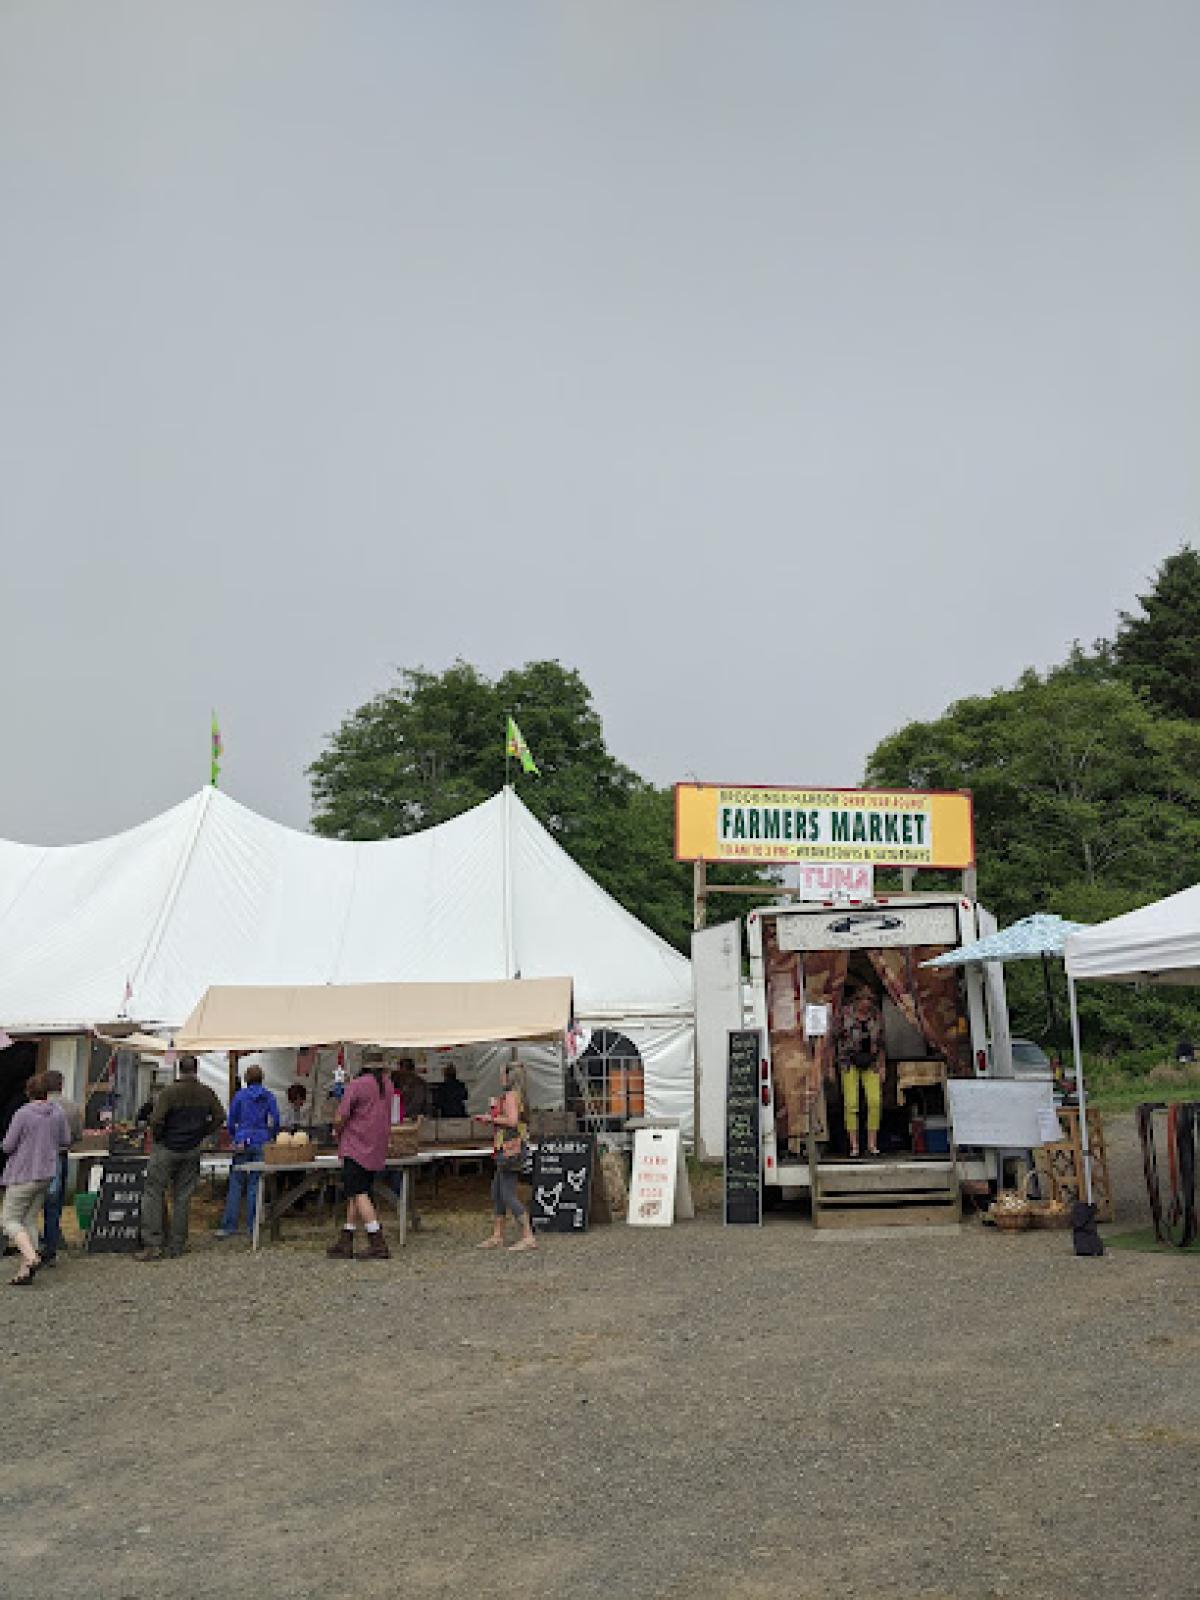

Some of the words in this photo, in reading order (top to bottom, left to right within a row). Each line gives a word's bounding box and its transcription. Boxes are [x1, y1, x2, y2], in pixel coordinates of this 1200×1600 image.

[722, 808, 820, 841] FARMERS
[830, 811, 926, 844] MARKET
[801, 867, 869, 890] TUNA
